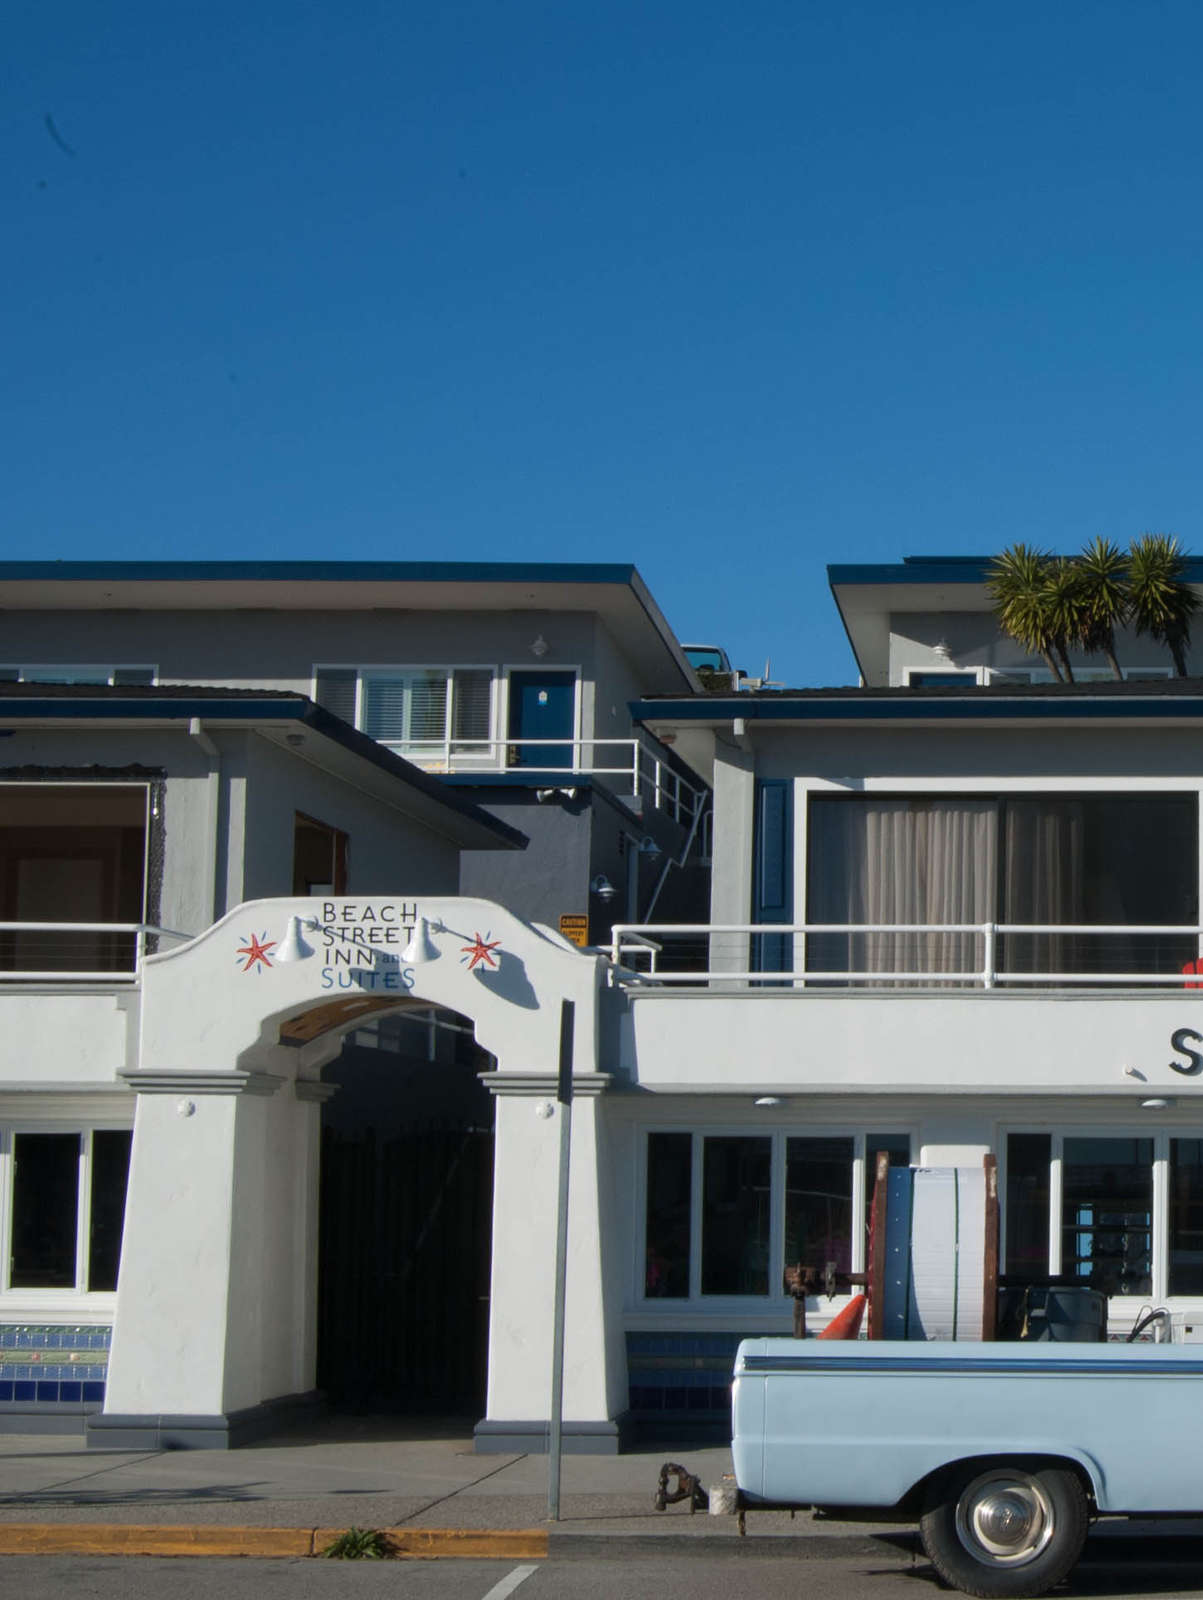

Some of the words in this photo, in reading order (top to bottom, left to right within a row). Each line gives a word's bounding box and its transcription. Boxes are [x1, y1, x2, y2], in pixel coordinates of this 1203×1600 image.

[323, 902, 417, 922] BEACH
[322, 925, 415, 946] STREET
[325, 948, 373, 965] INN
[381, 952, 409, 964] an
[321, 967, 415, 989] SUITES
